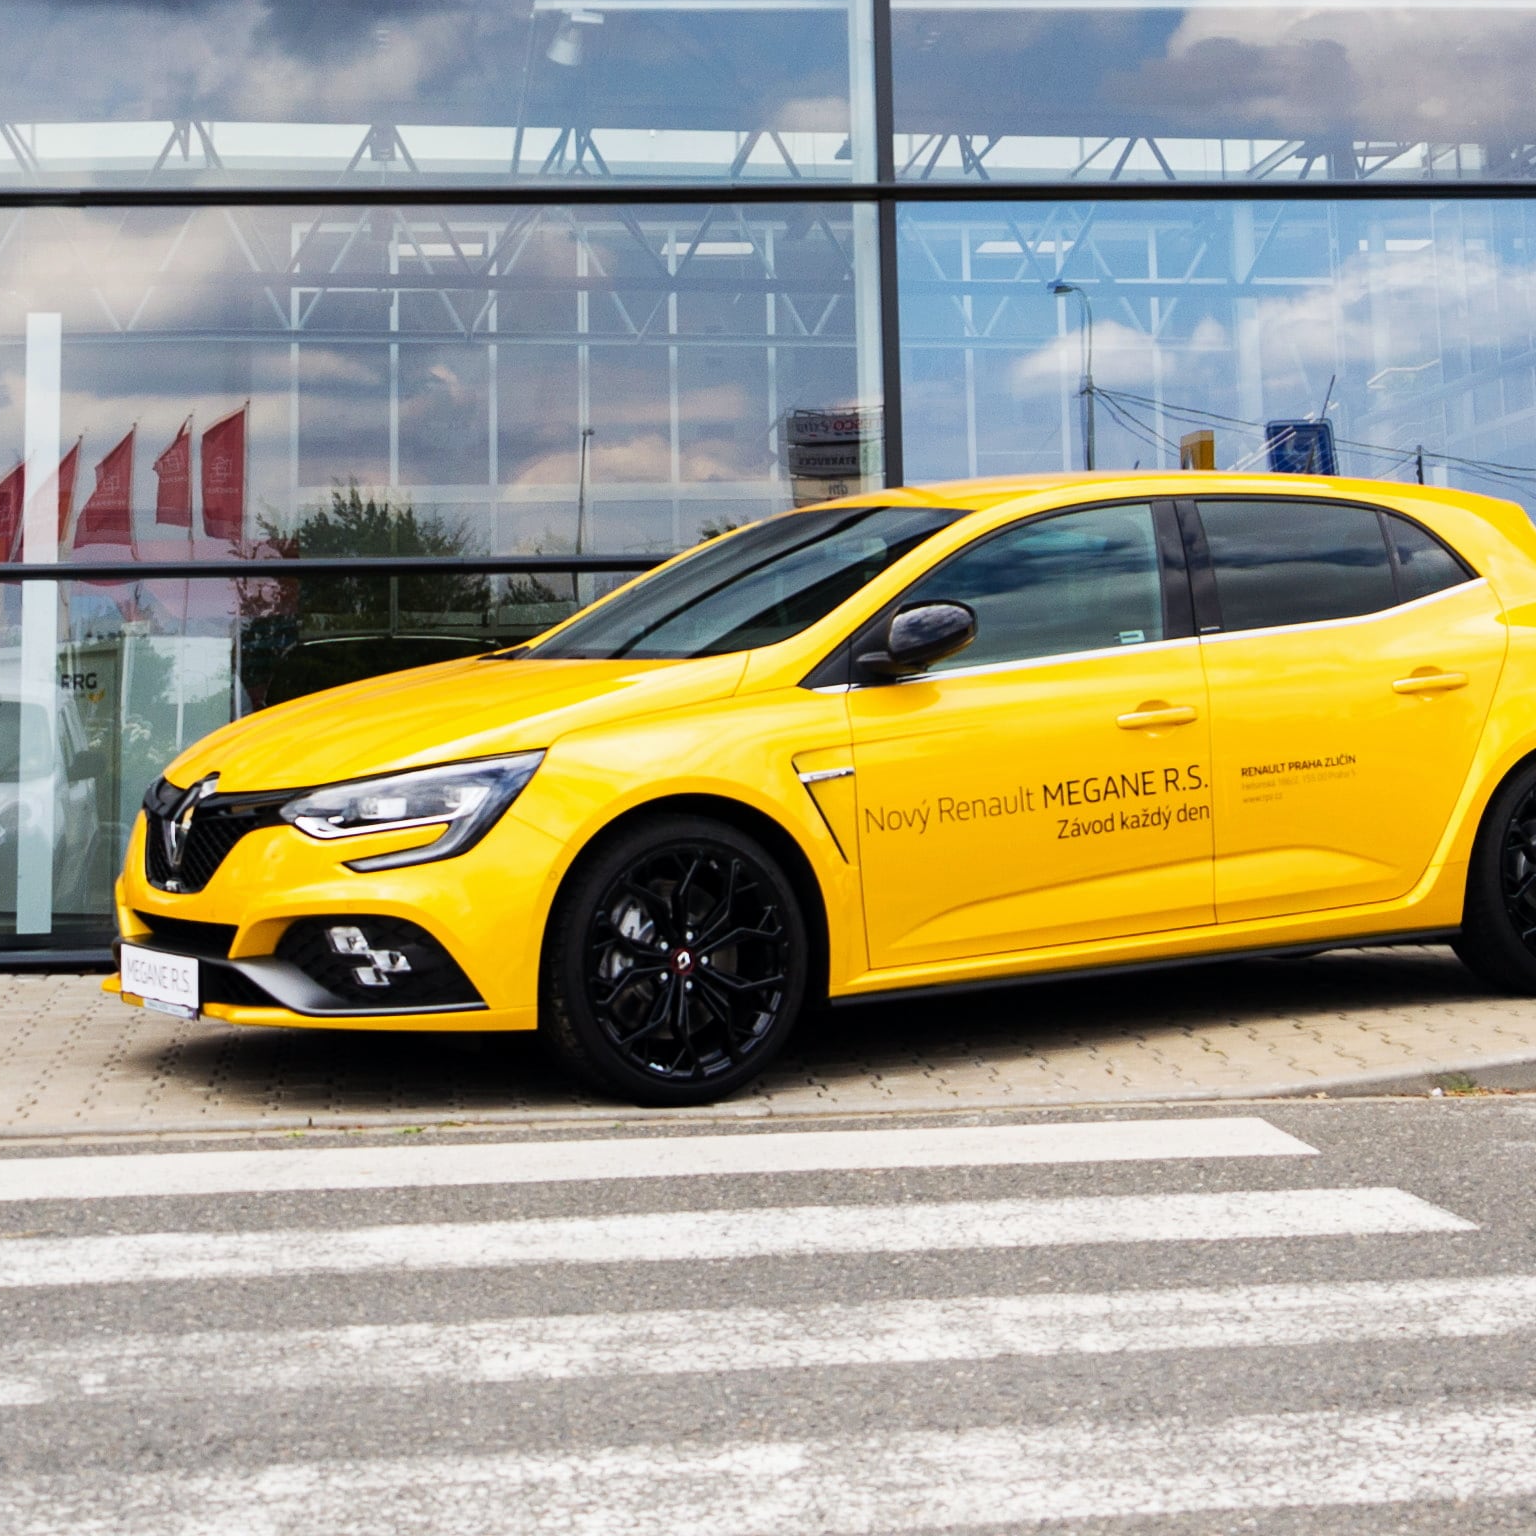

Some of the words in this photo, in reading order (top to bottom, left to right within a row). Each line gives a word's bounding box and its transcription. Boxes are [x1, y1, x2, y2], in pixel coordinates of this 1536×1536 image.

[1240, 762, 1286, 777] RENAULT
[1288, 759, 1323, 772] PRAHA
[864, 798, 931, 835] Nový
[937, 785, 1036, 823] Renault
[1042, 769, 1157, 809] MEGANE
[1163, 764, 1209, 793] R.S.
[1057, 812, 1115, 840] Závod
[1120, 804, 1172, 831] každý
[1177, 802, 1210, 824] den
